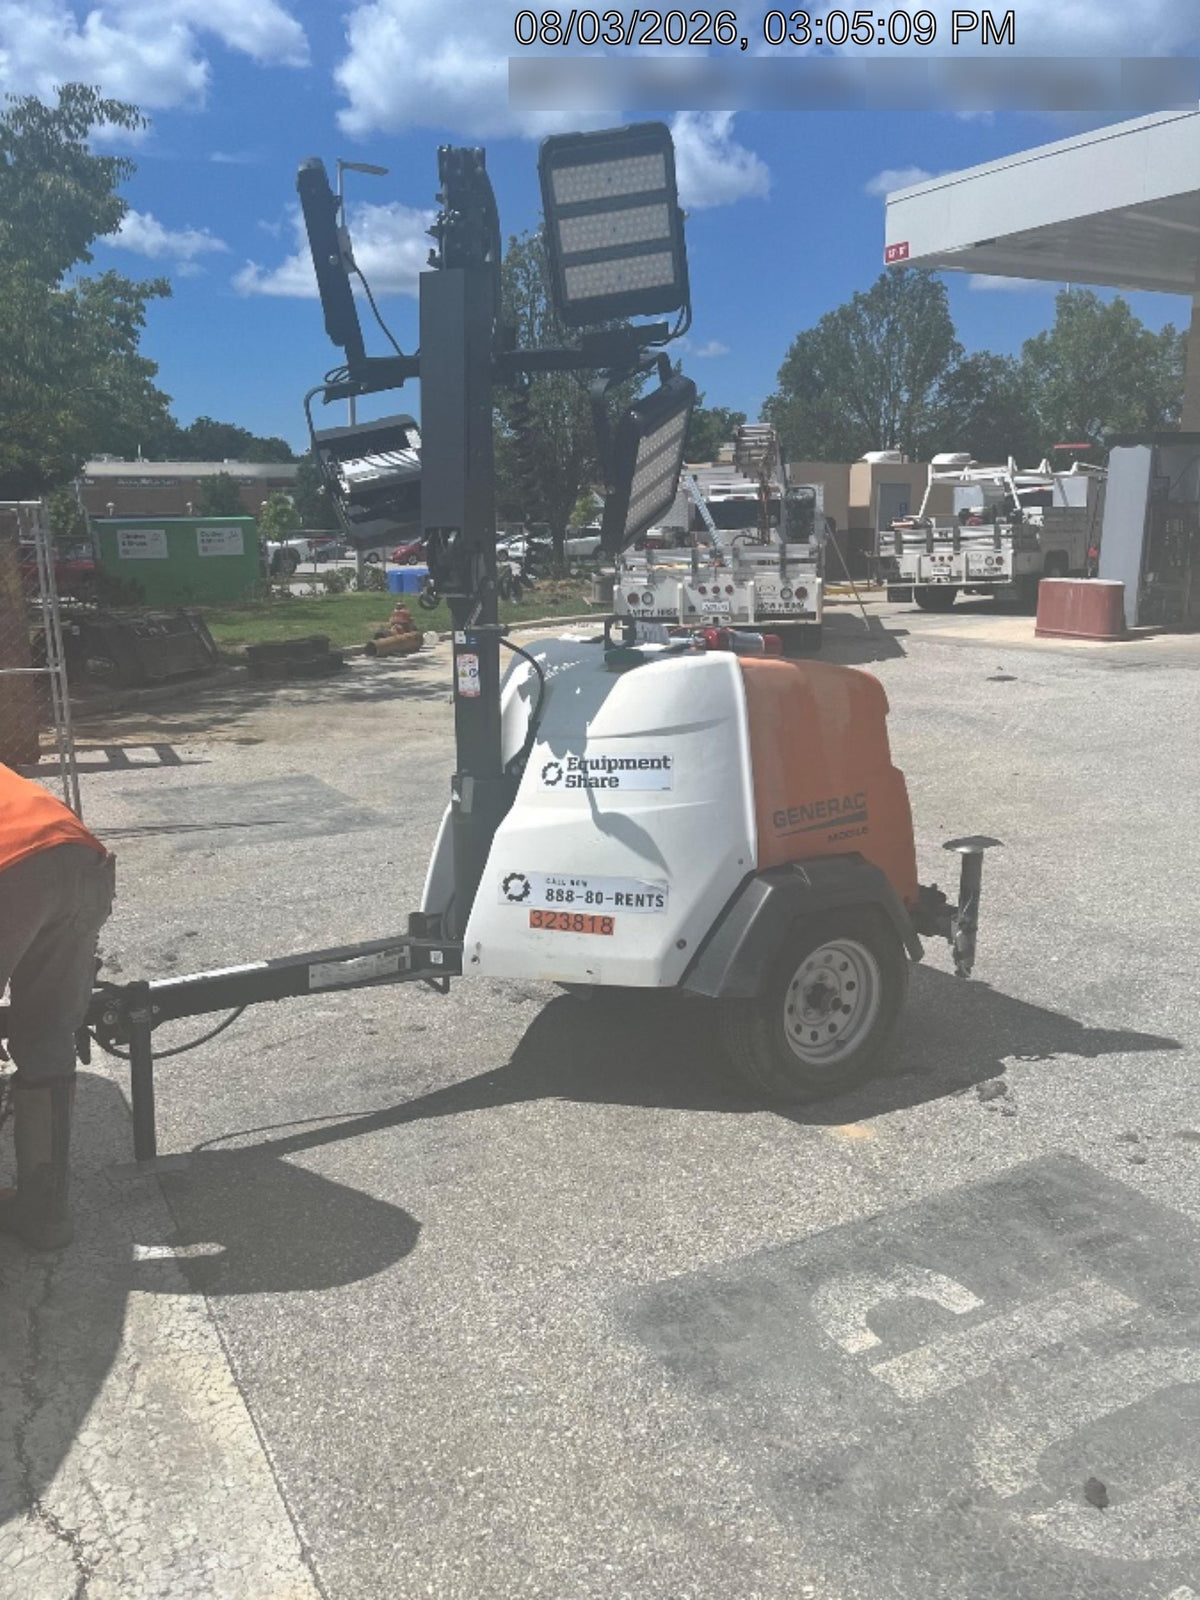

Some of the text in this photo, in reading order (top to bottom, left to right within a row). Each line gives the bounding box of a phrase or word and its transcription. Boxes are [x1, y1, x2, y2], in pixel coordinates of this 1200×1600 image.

[566, 755, 671, 773] Equipment
[565, 775, 619, 788] Share
[773, 791, 867, 828] GENERAC
[545, 888, 665, 908] 888-80-RENTS
[530, 909, 614, 935] 323818
